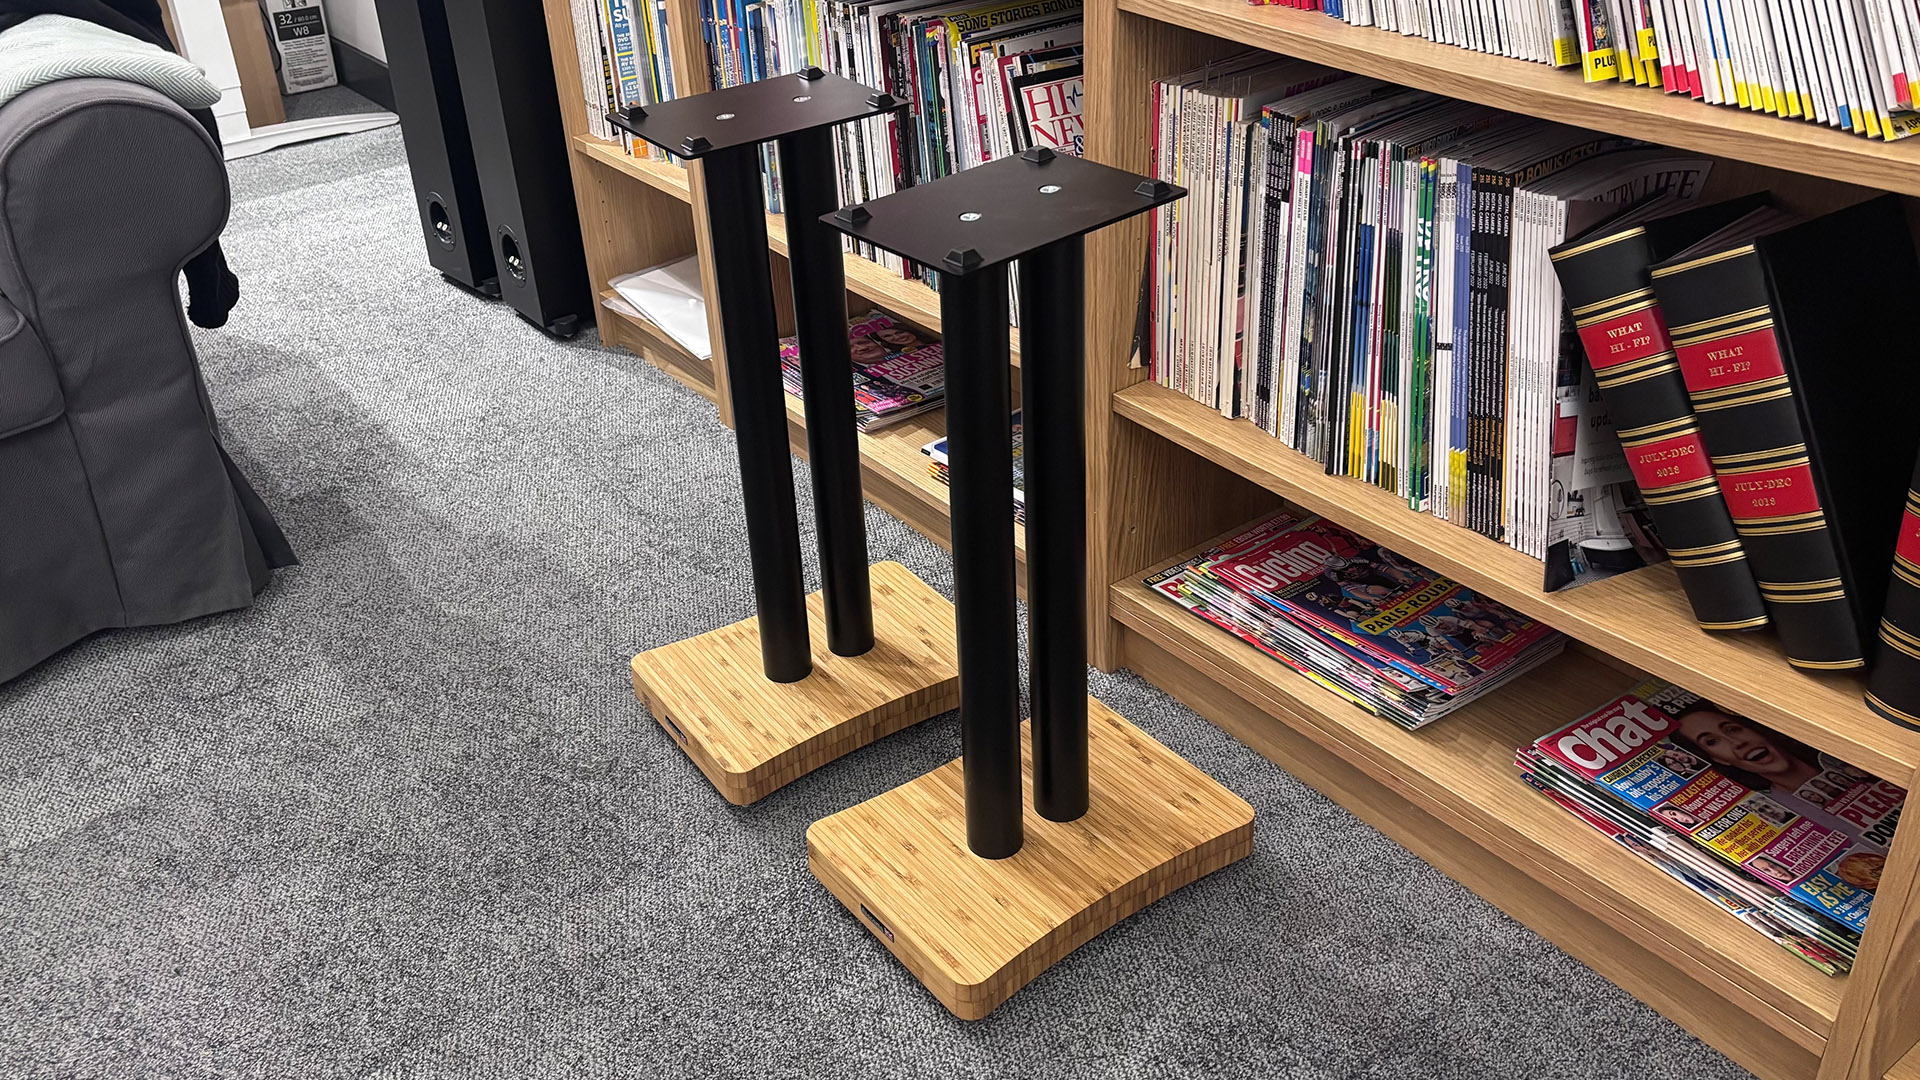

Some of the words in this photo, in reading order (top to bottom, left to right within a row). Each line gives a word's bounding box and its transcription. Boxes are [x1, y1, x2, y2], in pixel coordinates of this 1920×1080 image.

[279, 14, 292, 25] 32
[950, 14, 968, 22] PLUS
[956, 16, 988, 33] SONG
[991, 4, 1040, 26] STORIES
[1042, 0, 1083, 13] BONUS
[293, 26, 309, 36] W8
[1595, 55, 1615, 69] PLUS
[1407, 142, 1421, 156] FREE
[1515, 173, 1524, 186] 12
[1526, 155, 1562, 182] BONUS
[1607, 322, 1643, 339] WHAT
[1610, 342, 1625, 354] HI
[1632, 335, 1651, 348] FI?
[1707, 346, 1743, 361] WHAT
[880, 357, 912, 372] WILL
[1708, 367, 1725, 377] HI
[1734, 361, 1751, 372] FI?
[1639, 445, 1696, 464] JULY-DEC
[1734, 477, 1792, 492] JULY-DEC
[1220, 541, 1236, 551] FREE
[1149, 572, 1164, 584] FREE
[1163, 565, 1180, 577] VIDEO
[1234, 541, 1332, 590] Cycling
[1663, 704, 1680, 715] &
[1558, 700, 1668, 770] chat
[1602, 770, 1624, 783] CAUGHT
[1621, 765, 1631, 773] BY
[1628, 759, 1640, 769] HIS
[1637, 747, 1661, 763] PECKER!
[1612, 780, 1635, 791] How
[1628, 764, 1660, 783] hubby's
[1626, 787, 1646, 798] bits
[1642, 769, 1673, 791] exposed
[1645, 792, 1663, 802] his
[1658, 780, 1680, 795] affair
[1670, 794, 1685, 806] HER
[1682, 783, 1700, 799] LAST
[1698, 771, 1719, 788] SELFIE
[1681, 796, 1706, 812] Hours
[1701, 785, 1721, 801] later
[1717, 778, 1734, 790] my
[1697, 807, 1713, 820] girl
[1706, 798, 1728, 814] WAS
[1722, 786, 1743, 803] DEAD
[1698, 823, 1719, 840] MEAL
[1715, 815, 1731, 830] FOR
[1730, 807, 1747, 822] ONE
[1714, 836, 1726, 846] He
[1724, 825, 1746, 841] cooked
[1743, 819, 1754, 830] his
[1720, 843, 1738, 854] lover
[1735, 834, 1751, 848] then
[1747, 821, 1769, 840] served
[1734, 848, 1747, 859] her
[1745, 841, 1761, 853] with
[1756, 830, 1777, 847] lemon
[1765, 833, 1794, 857] Surgery
[1786, 826, 1803, 844] left
[1801, 821, 1814, 833] me
[1786, 831, 1824, 864] BREATHING
[1792, 848, 1825, 876] THROUGH
[1819, 840, 1835, 856] MY
[1830, 831, 1845, 847] EYE
[1800, 874, 1833, 896] EASY
[1817, 891, 1840, 909] AS
[1829, 882, 1855, 900] PIE
